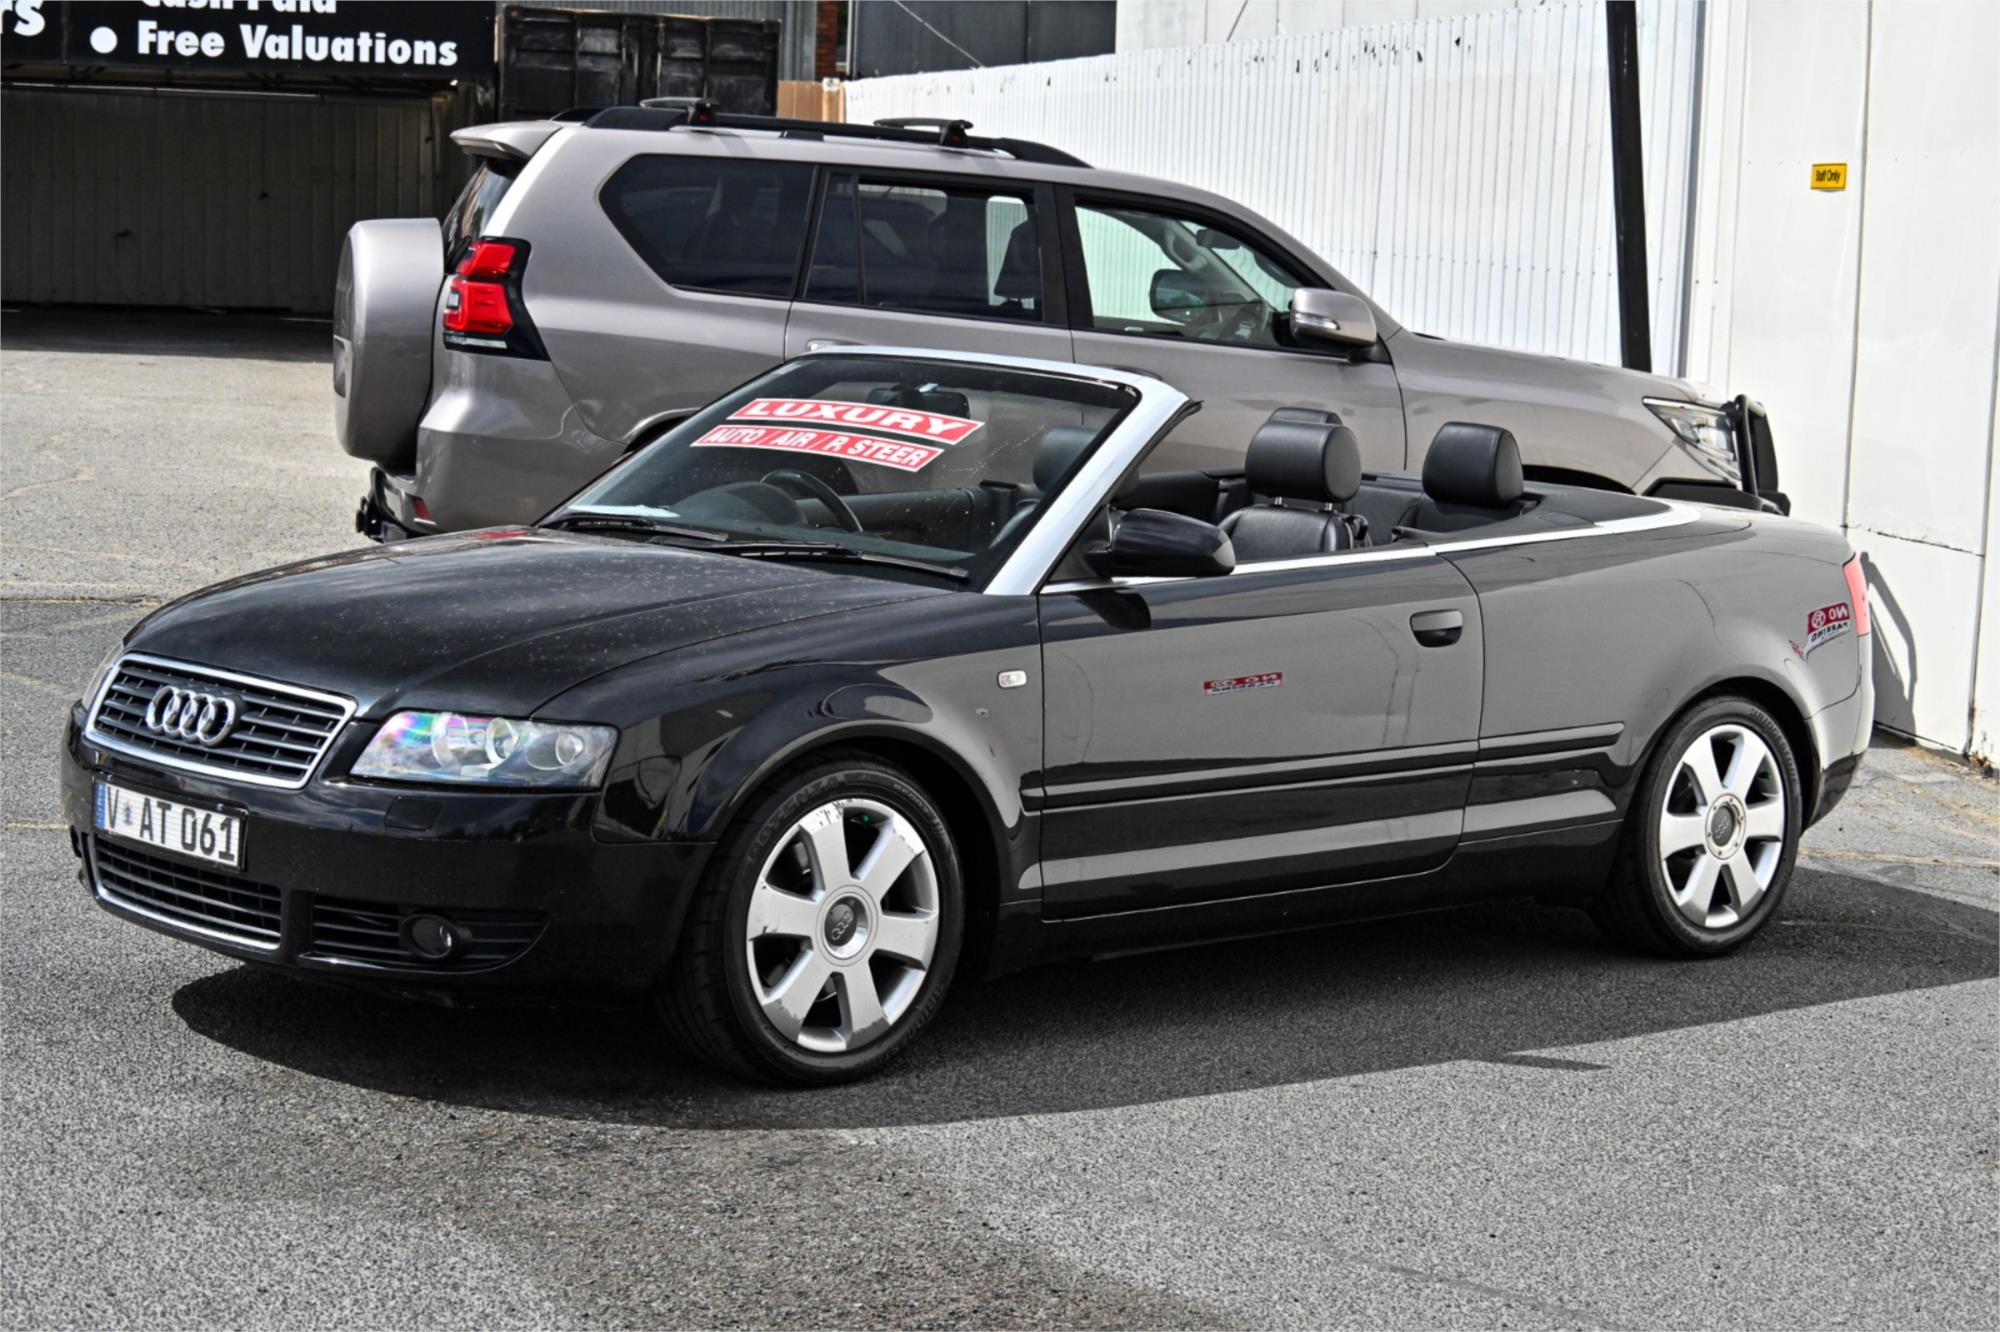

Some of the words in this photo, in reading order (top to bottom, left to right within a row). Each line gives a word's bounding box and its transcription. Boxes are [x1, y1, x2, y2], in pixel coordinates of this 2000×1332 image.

[137, 20, 226, 58] Free
[239, 24, 458, 66] Valuations
[744, 402, 966, 435] LUXURY
[702, 427, 767, 443] AUTO
[769, 431, 817, 447] AIR
[847, 439, 929, 466] STEER
[107, 786, 119, 829] V
[140, 797, 172, 844] AT
[181, 807, 235, 861] 061
